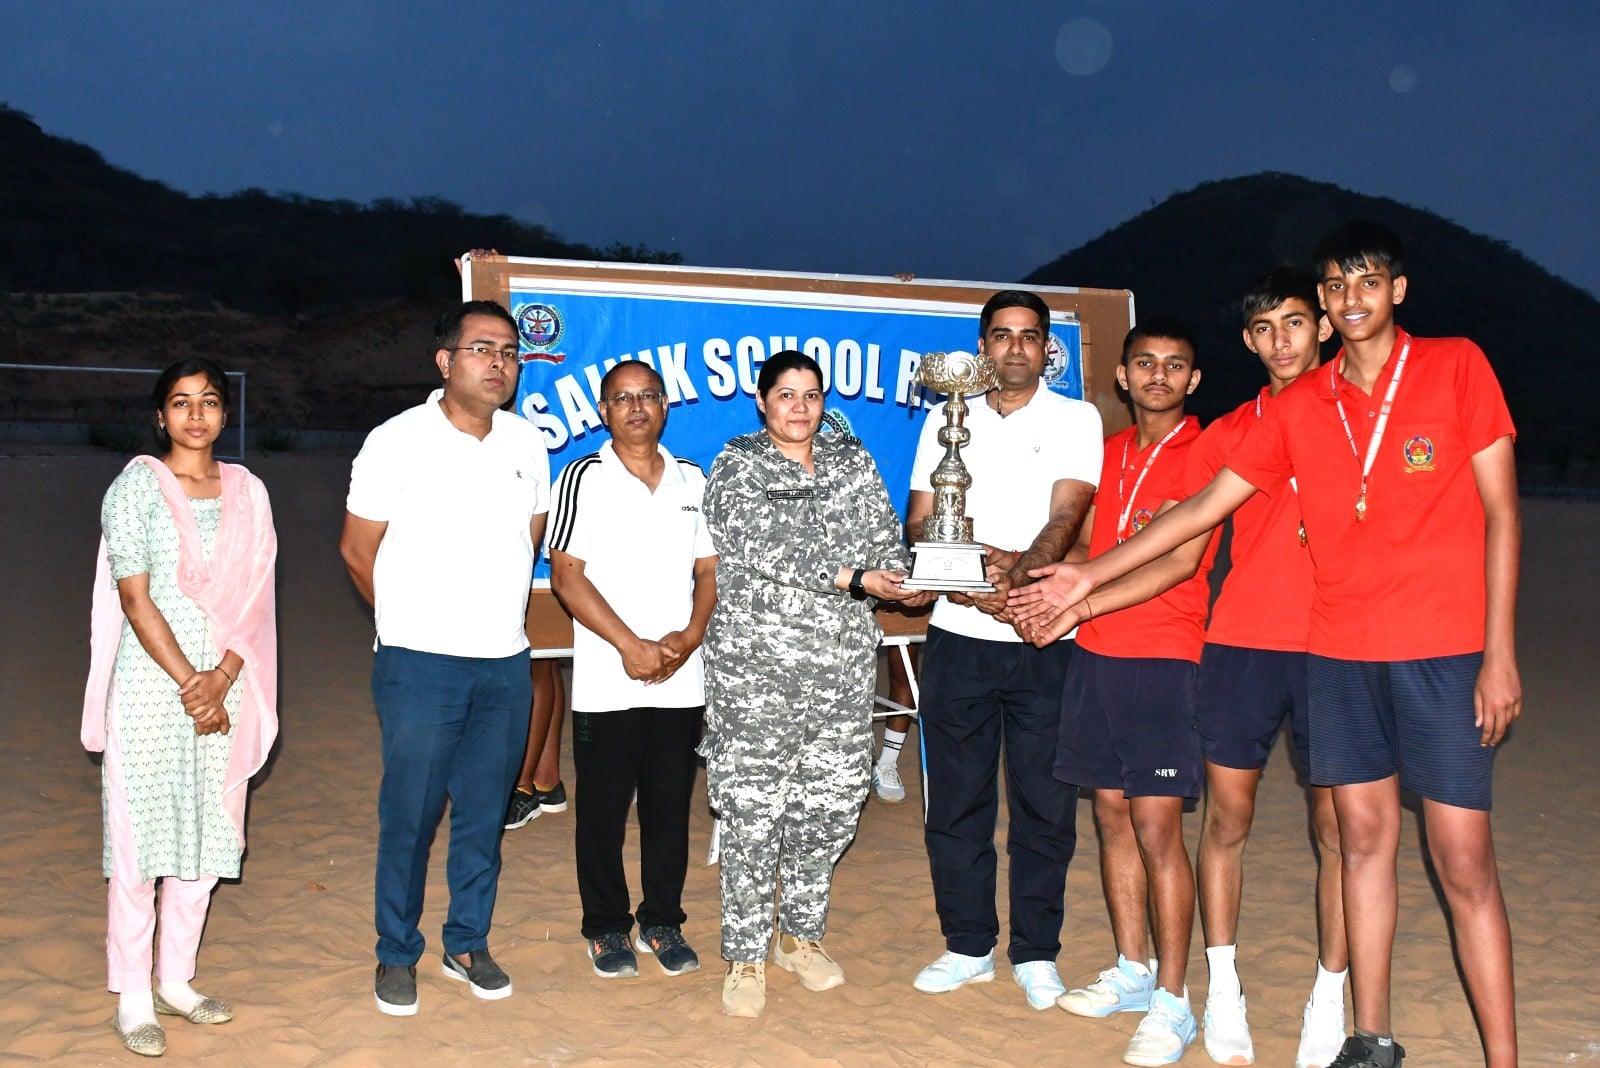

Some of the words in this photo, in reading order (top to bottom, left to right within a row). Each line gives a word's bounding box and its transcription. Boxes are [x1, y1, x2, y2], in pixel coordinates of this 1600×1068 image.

[521, 341, 699, 452] SAK
[702, 335, 885, 400] SCOOL
[821, 412, 842, 433] CHOO
[1154, 768, 1178, 778] SRW
